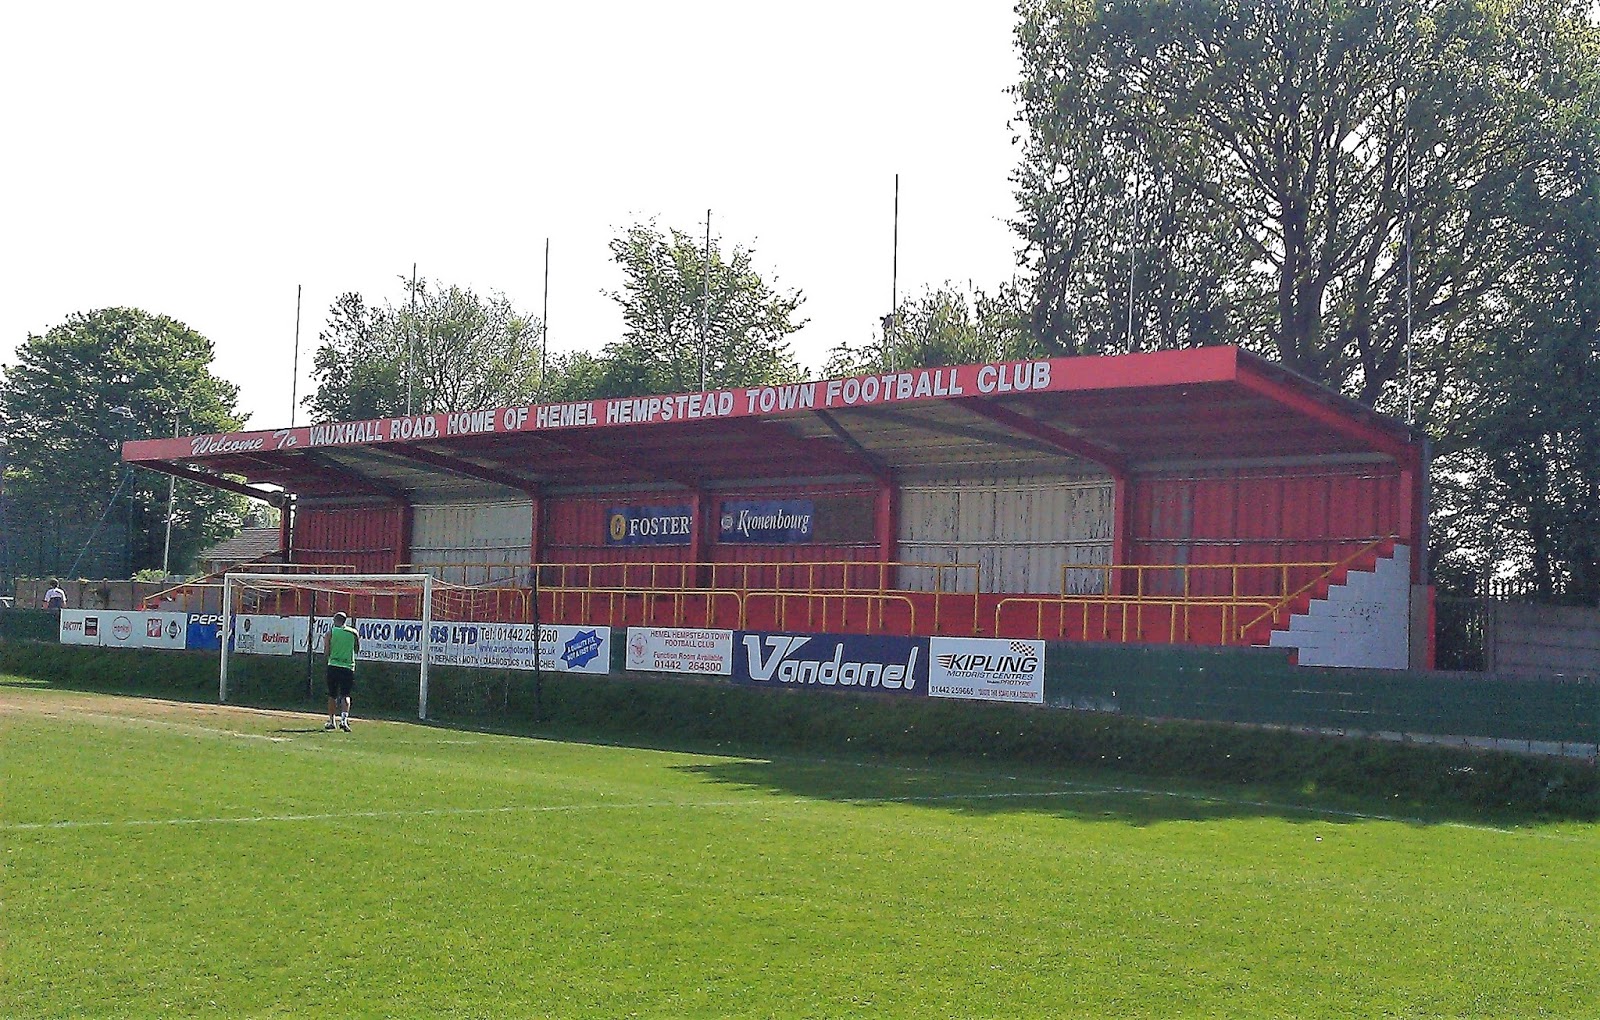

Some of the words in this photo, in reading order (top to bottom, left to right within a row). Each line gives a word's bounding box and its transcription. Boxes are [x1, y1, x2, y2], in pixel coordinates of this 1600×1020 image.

[191, 435, 263, 455] Welcome
[273, 430, 298, 449] To
[310, 421, 382, 445] VAUXHALL
[390, 416, 439, 439] ROAD,
[447, 410, 495, 434] HOME
[504, 407, 529, 430] OF
[536, 403, 597, 428] HEMEL
[606, 392, 734, 423] HEMPSTEAD
[746, 384, 815, 413] TOWN
[826, 369, 963, 406] FOOTBALL
[977, 361, 1051, 393] CLUB
[736, 509, 811, 538] Kronenbourg
[359, 623, 391, 641] AVCO
[394, 624, 449, 643] MOTRS
[451, 626, 478, 645] LTD
[480, 627, 495, 640] Tel:
[497, 628, 523, 641] 01442
[525, 629, 558, 643] 26260
[650, 630, 671, 638] HEMEL
[673, 631, 709, 640] HEMPSTEAD
[711, 632, 730, 641] TOWN
[665, 639, 696, 648] FOOTBALL
[697, 641, 715, 649] CLUB
[653, 651, 677, 660] Function
[678, 652, 695, 660] Room
[524, 658, 556, 669] CLUCHES
[654, 660, 681, 669] 01442
[688, 661, 722, 671] 264300
[742, 634, 919, 690] Vandanel
[949, 654, 1039, 673] KIPLING
[946, 670, 990, 679] MOTORIST
[992, 672, 1034, 680] CENTRES
[931, 685, 950, 694] 01442
